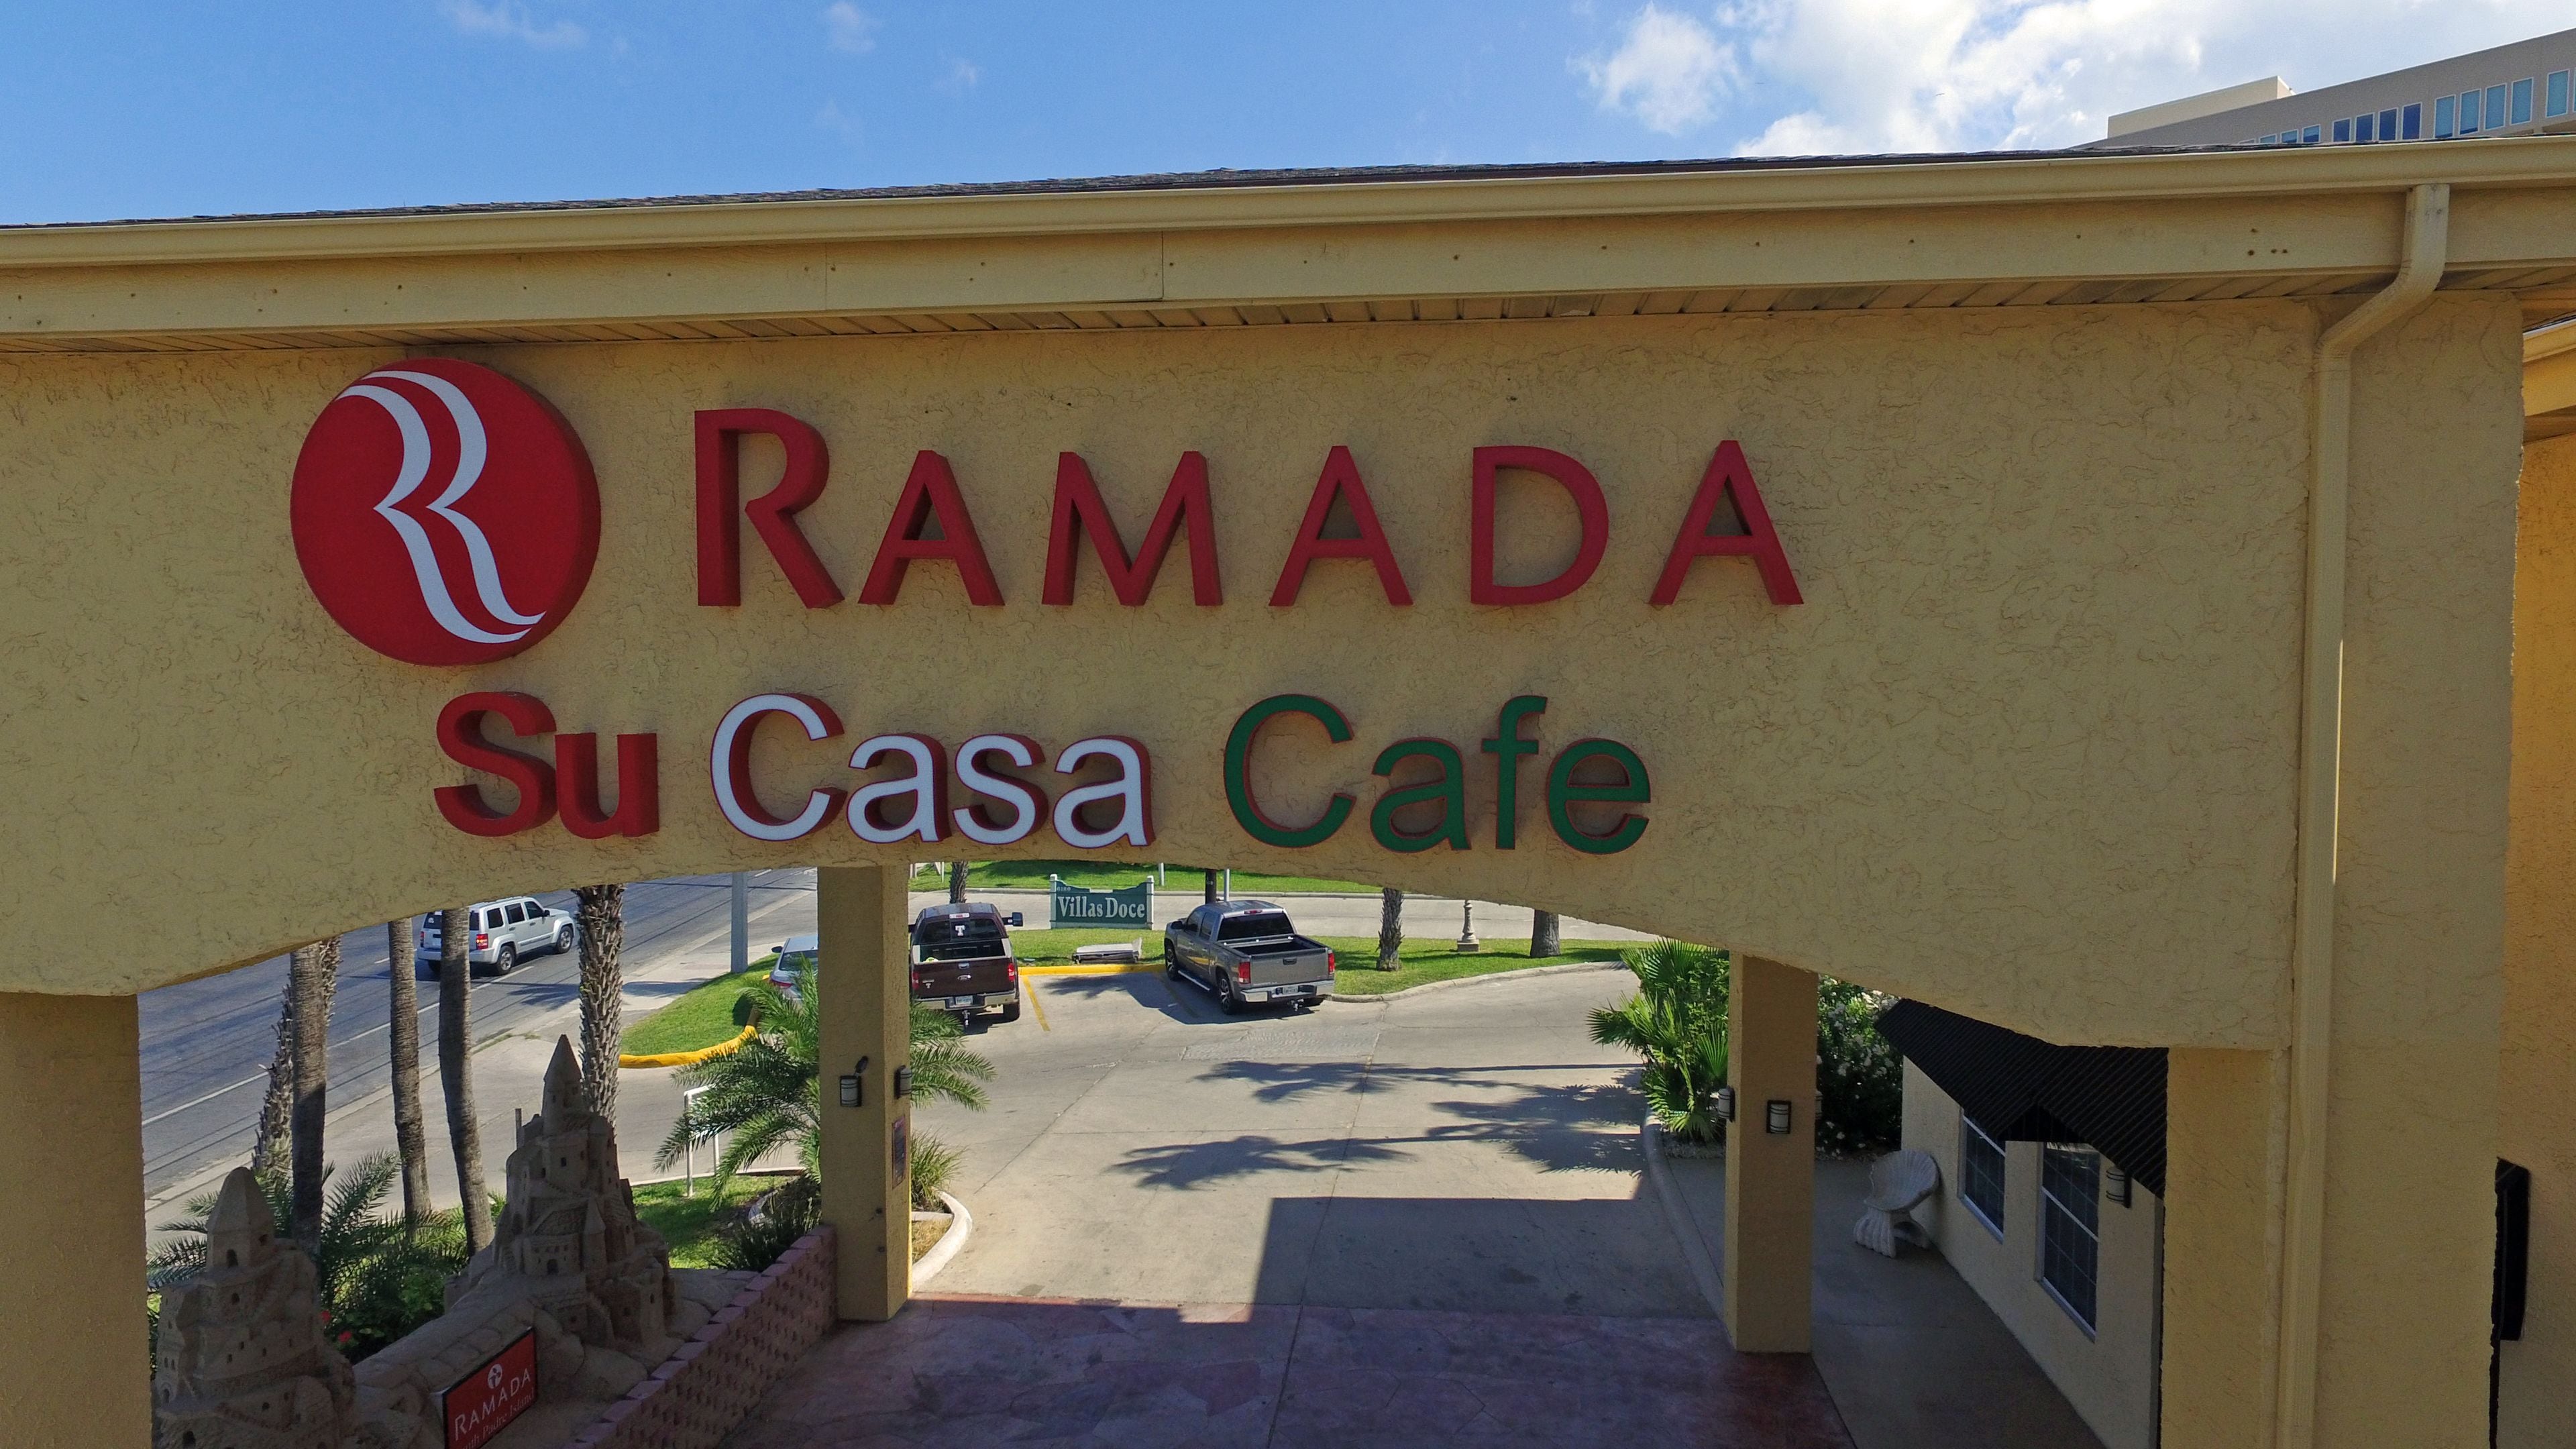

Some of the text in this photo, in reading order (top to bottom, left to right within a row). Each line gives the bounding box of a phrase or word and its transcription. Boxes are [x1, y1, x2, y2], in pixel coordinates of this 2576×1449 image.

[694, 408, 1803, 609] RAMADA
[433, 691, 1651, 854] Su Casa Cafe
[1057, 896, 1145, 918] Villas Doce
[454, 1368, 531, 1441] RAMADA
